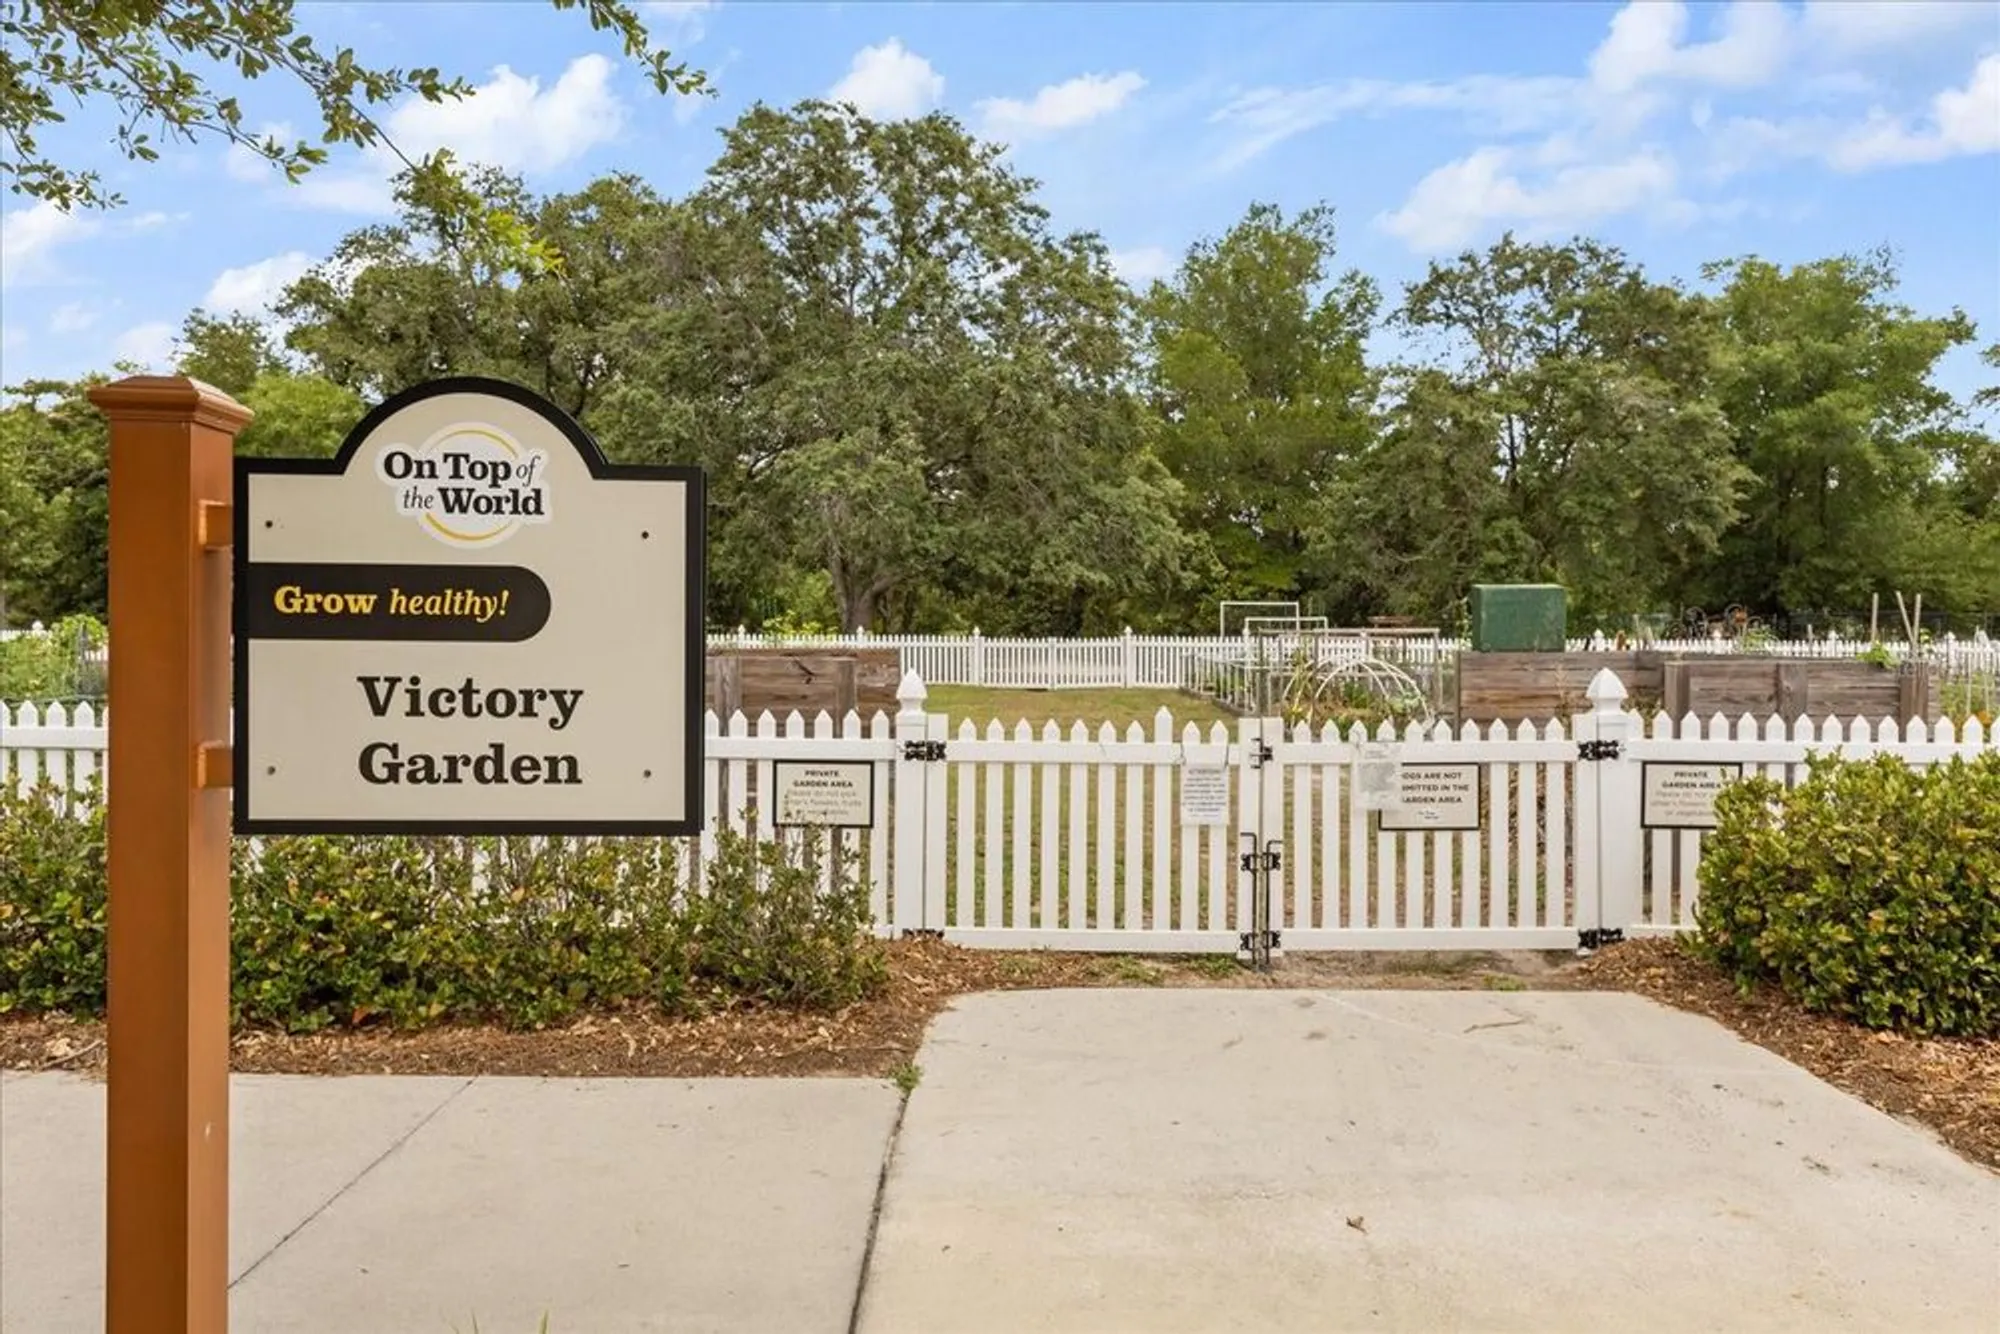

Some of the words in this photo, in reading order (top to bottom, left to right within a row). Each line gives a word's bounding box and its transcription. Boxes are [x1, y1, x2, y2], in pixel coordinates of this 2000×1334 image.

[384, 451, 438, 479] On
[443, 453, 511, 488] Top
[516, 455, 541, 487] of
[404, 486, 434, 509] the
[437, 487, 544, 515] World
[275, 586, 377, 613] Grow
[390, 589, 509, 622] healthy!
[357, 676, 583, 730] Victory
[359, 742, 582, 784] Garden
[1401, 771, 1421, 779] OGS
[1424, 771, 1441, 779] ARE
[1443, 771, 1462, 779] NOT
[1438, 795, 1463, 803] AREA
[1452, 783, 1469, 791] THE
